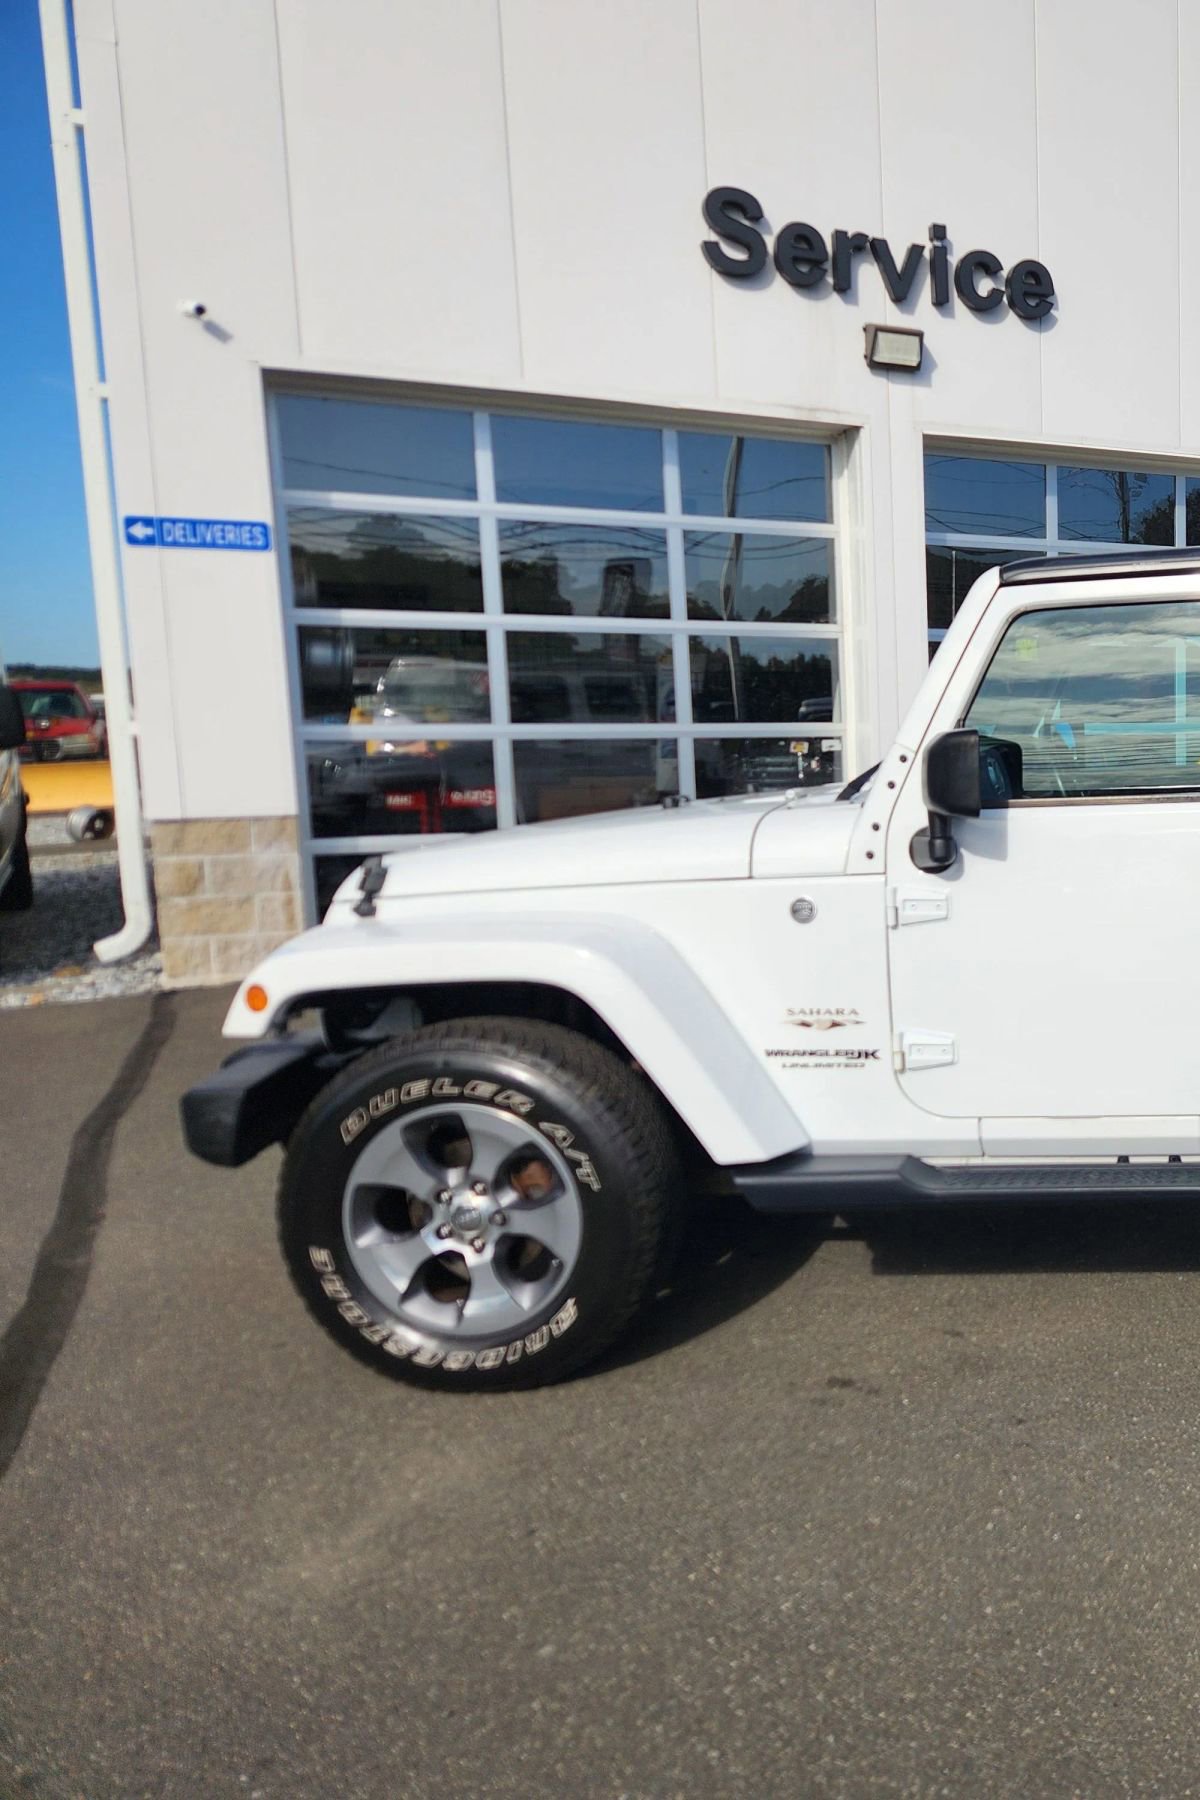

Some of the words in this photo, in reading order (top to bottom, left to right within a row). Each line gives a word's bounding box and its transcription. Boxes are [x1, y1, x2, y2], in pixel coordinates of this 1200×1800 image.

[701, 185, 1055, 320] Service
[162, 521, 267, 547] DELIVERIES
[786, 1007, 860, 1016] SAHARA
[764, 1048, 855, 1058] WRANGLER
[340, 1076, 536, 1146] DUELER
[308, 1244, 580, 1372] BRIDGESTONE
